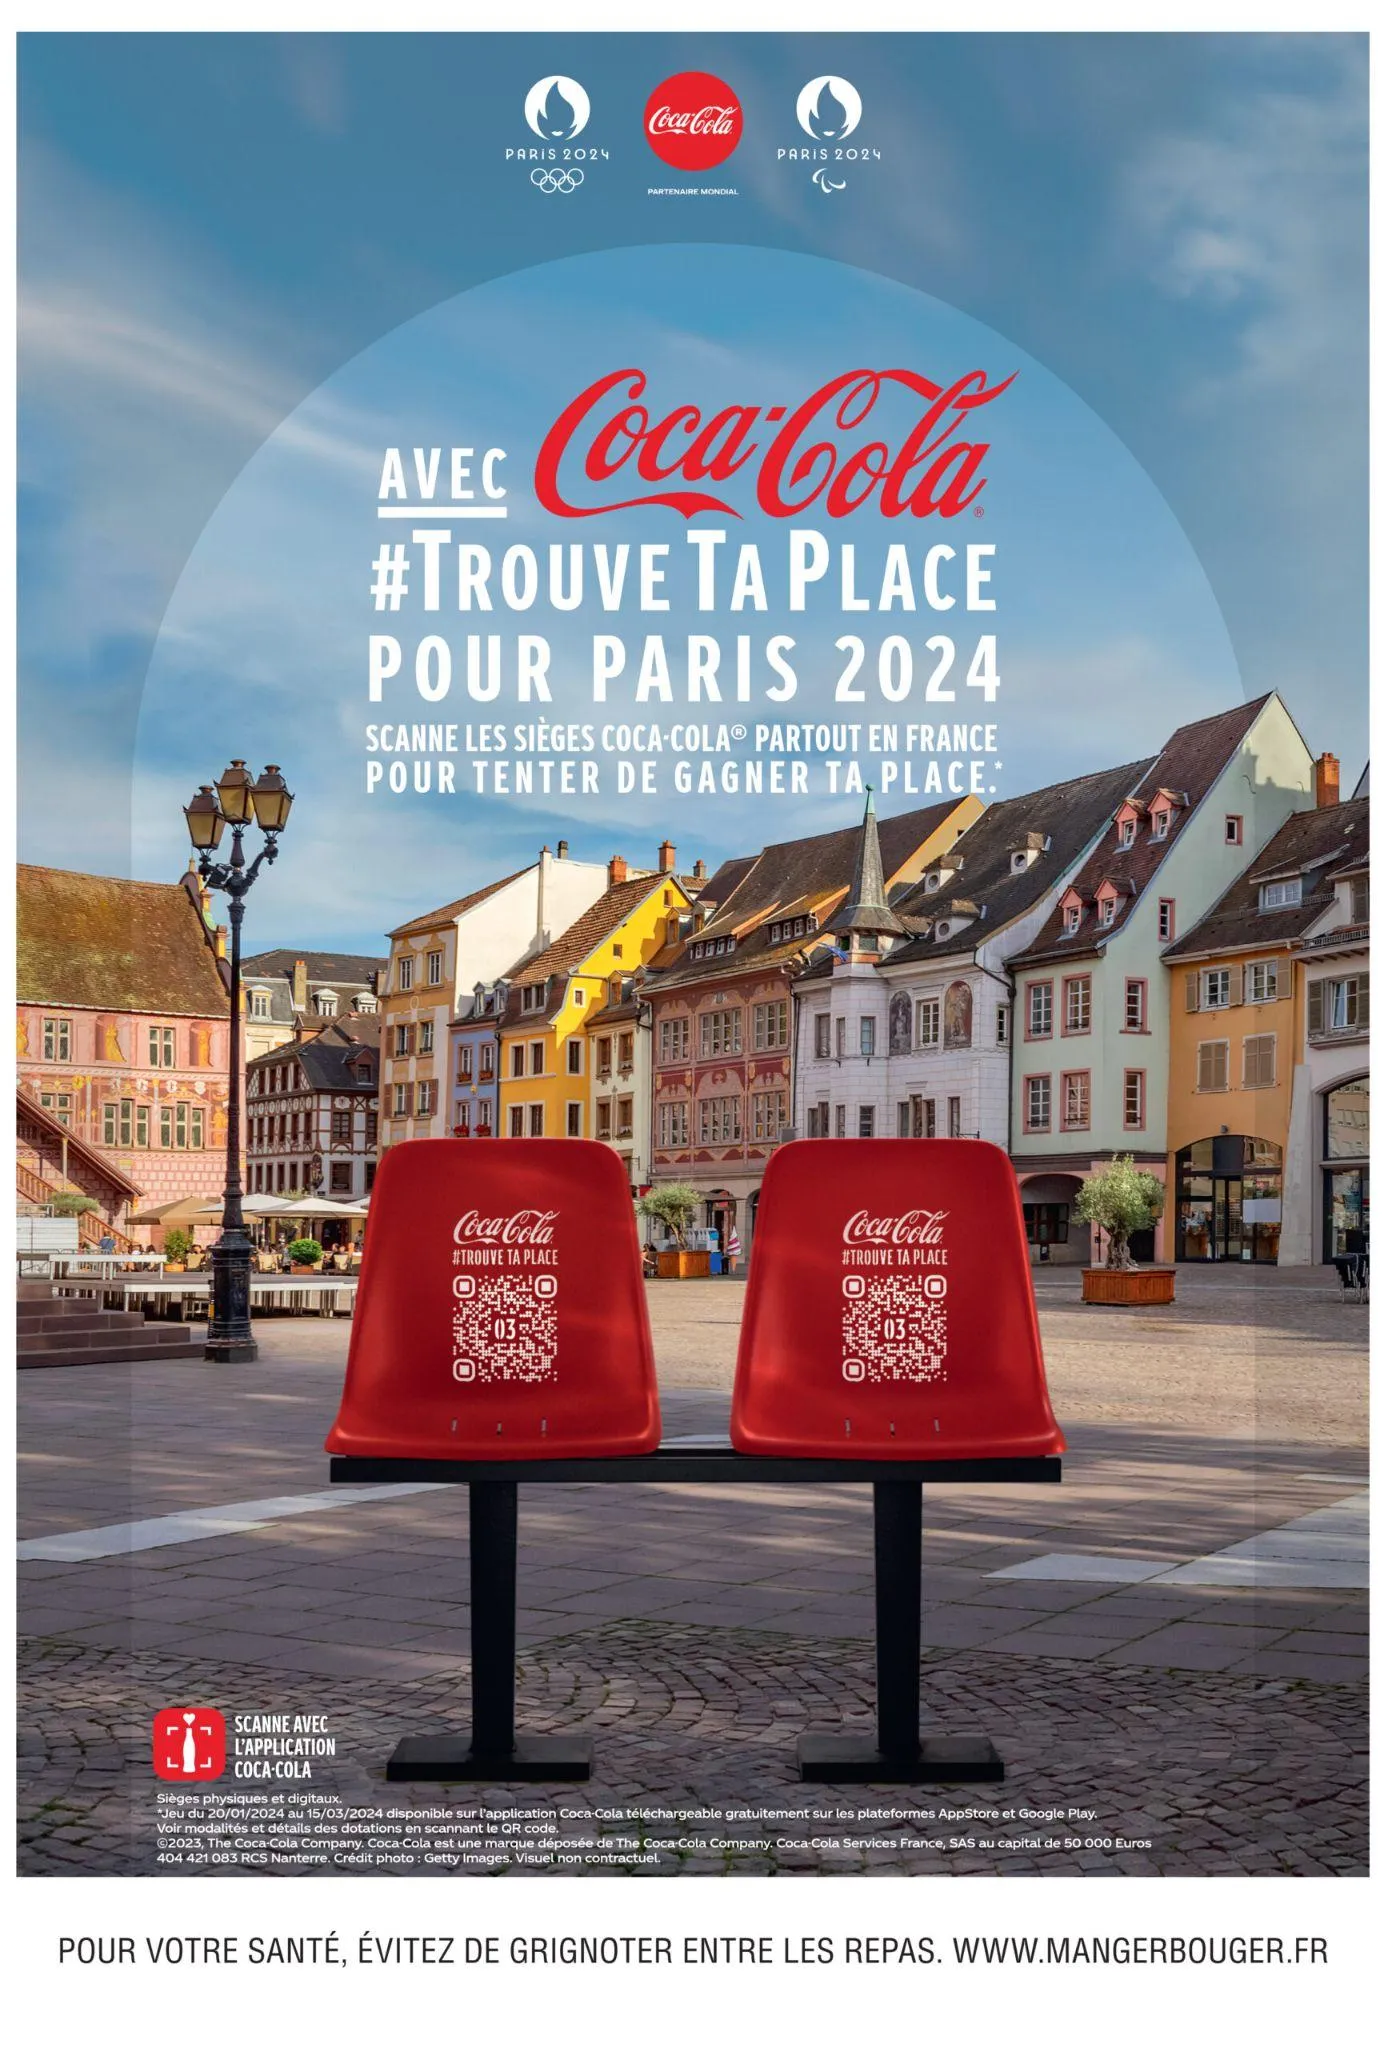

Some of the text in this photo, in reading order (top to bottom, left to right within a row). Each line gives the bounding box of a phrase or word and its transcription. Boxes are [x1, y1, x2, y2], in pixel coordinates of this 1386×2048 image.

[648, 105, 738, 134] Coca-Cola
[506, 148, 609, 160] PARIS 2024
[777, 148, 881, 160] PARIS 2024
[378, 448, 508, 499] AVEC
[369, 635, 1001, 702] POUR PARIS 2024
[366, 724, 458, 752] SCANNE
[466, 724, 507, 752] LES
[514, 717, 595, 752] SIÈGES
[756, 724, 862, 752] PARTOUT
[869, 724, 898, 752] EN
[906, 724, 997, 752] FRANCE
[367, 761, 456, 793] POUR
[472, 761, 599, 794] TENTER
[618, 761, 657, 793] DE
[674, 761, 808, 794] GAGNER
[826, 761, 863, 793] TA
[453, 1210, 560, 1245] Coca-Cola
[843, 1210, 950, 1245] Coca-Cola
[452, 1249, 559, 1266] #TROUVE TA PLACE
[842, 1249, 948, 1266] #TROUVE TA PLACE
[494, 1318, 516, 1340] 03
[883, 1318, 906, 1340] 03
[234, 1715, 329, 1733] SCANNE AVEC
[157, 1793, 342, 1806] Sièges physiques et digitaux.
[187, 1808, 205, 1819] du
[208, 1808, 284, 1819] 20/01/2024
[288, 1810, 304, 1819] au
[307, 1808, 384, 1819] 15/03/2024
[386, 1808, 453, 1821] disponible
[456, 1810, 477, 1819] sur
[560, 1808, 624, 1819] Coca-Cola
[626, 1808, 723, 1821] téléchargeable
[725, 1808, 810, 1821] gratuitement
[813, 1810, 834, 1819] sur
[836, 1808, 855, 1819] les
[857, 1808, 936, 1821] plateformes
[939, 1808, 1000, 1821] AppStore
[1002, 1808, 1016, 1819] et
[1018, 1808, 1065, 1821] Google
[1068, 1808, 1098, 1821] Play.
[156, 1822, 560, 1835] Voir modalités et détails des dotations en scannant le QR code.
[157, 1837, 1152, 1851] ©2023, The Coca-Cola Company. Coca-Cola est une marque déposée de The Coca-Cola Company. Coca-Cola Services France, SAS au capital de 50 000 Euros
[156, 1853, 183, 1863] 404
[186, 1853, 208, 1863] 421
[211, 1853, 238, 1863] 083
[241, 1853, 268, 1863] RCS
[271, 1853, 331, 1863] Nanterre.
[334, 1852, 374, 1863] Crédit
[376, 1852, 415, 1866] photo
[424, 1853, 460, 1866] Getty
[463, 1853, 513, 1866] Images.
[516, 1852, 555, 1863] Visuel
[557, 1855, 582, 1863] non
[585, 1852, 661, 1863] contractuel.
[59, 1931, 1328, 1967] POUR VOTRE SANTÉ, ÉVITEZ DE GRIGNOTER ENTRE LES REPAS. WWW.MANGERBOUGER.FR
